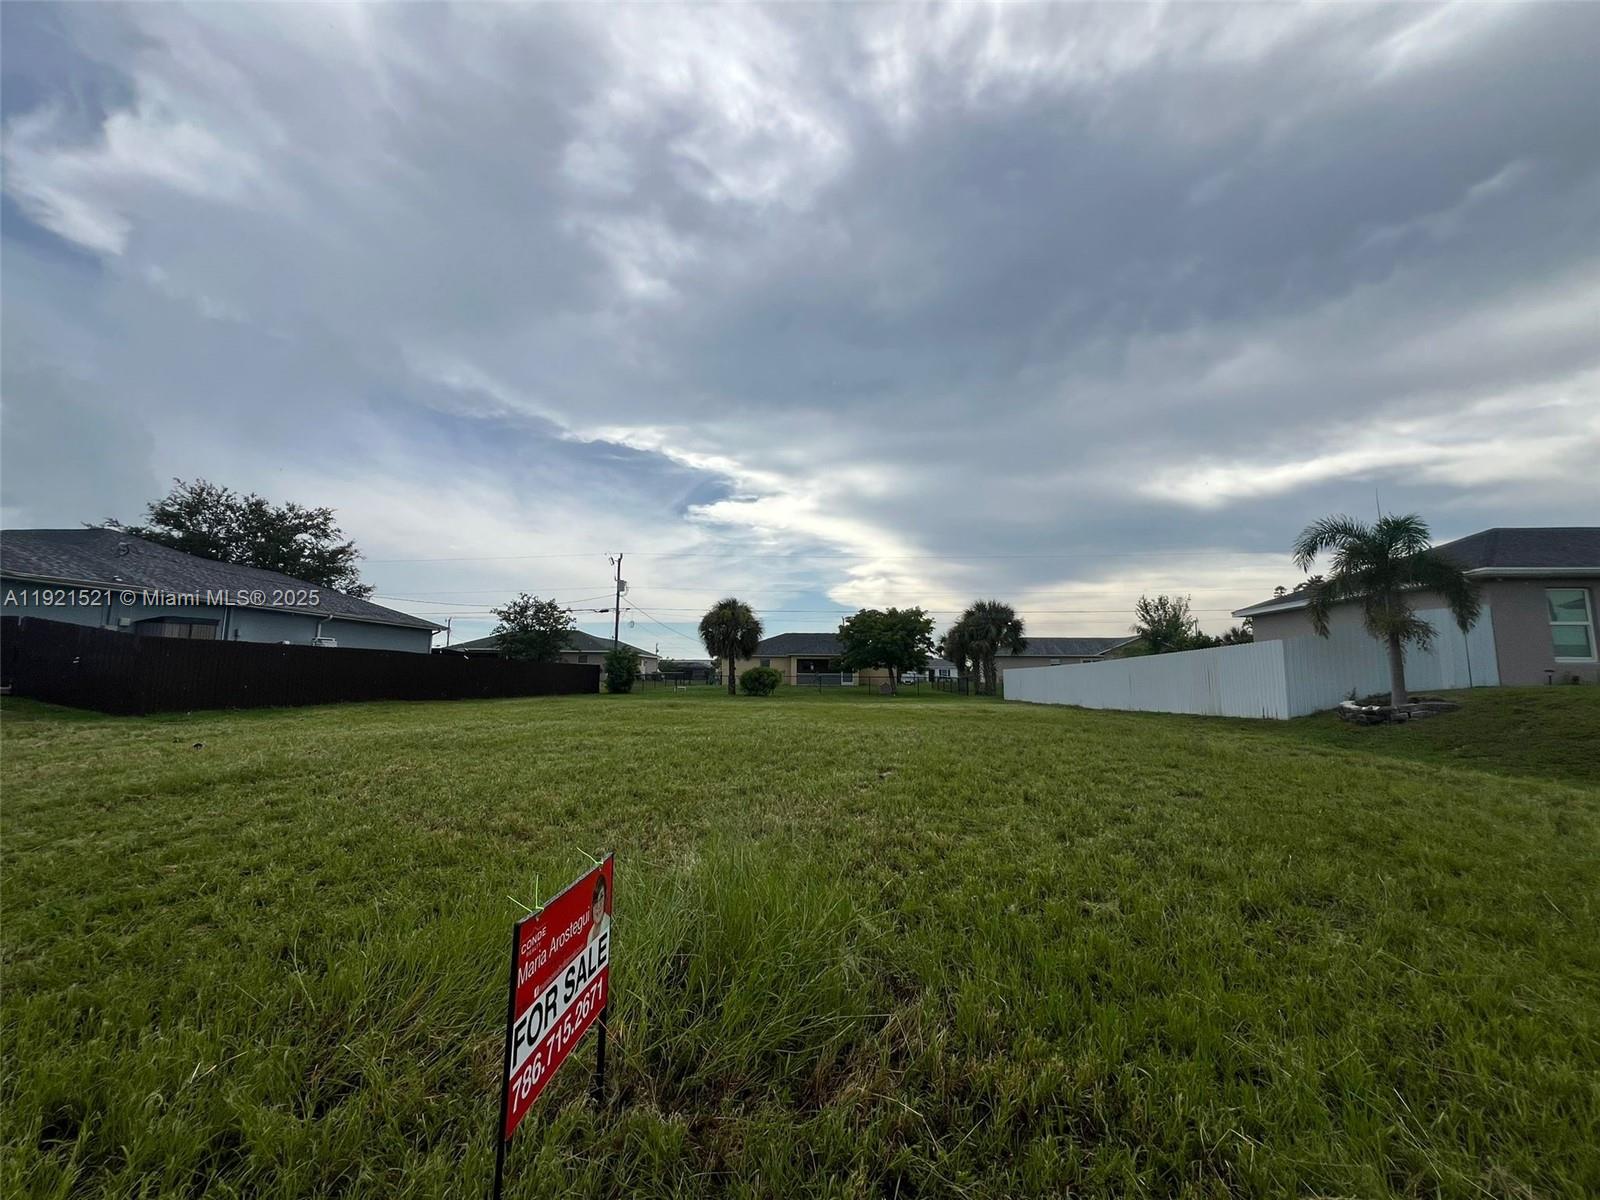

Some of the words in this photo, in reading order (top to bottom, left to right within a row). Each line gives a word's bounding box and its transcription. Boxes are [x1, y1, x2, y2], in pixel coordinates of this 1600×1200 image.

[517, 949, 547, 989] Maria
[548, 906, 591, 958] Arostegui
[521, 926, 547, 955] CONDE
[512, 984, 558, 1070] FOR
[564, 932, 608, 1004] SALE
[512, 977, 603, 1114] 786.715.2671
